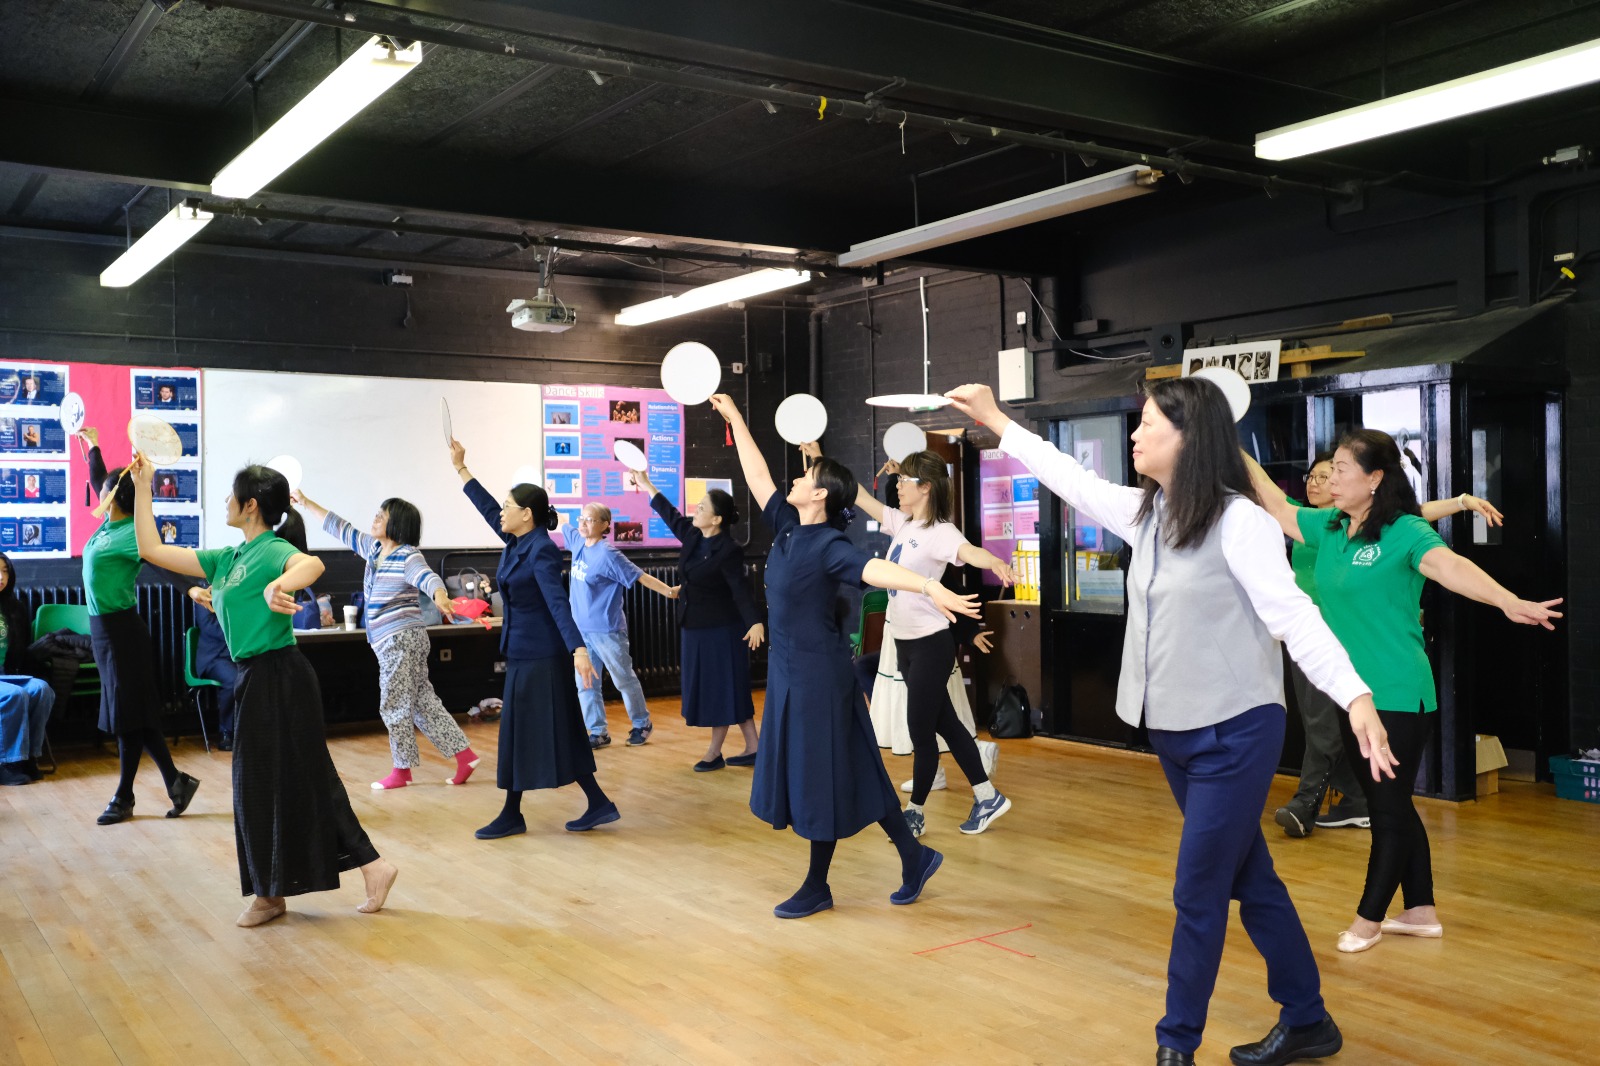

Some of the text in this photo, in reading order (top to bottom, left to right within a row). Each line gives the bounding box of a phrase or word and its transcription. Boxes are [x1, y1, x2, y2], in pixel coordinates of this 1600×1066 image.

[544, 385, 605, 398] Dance Skills
[982, 449, 1005, 459] Dance
